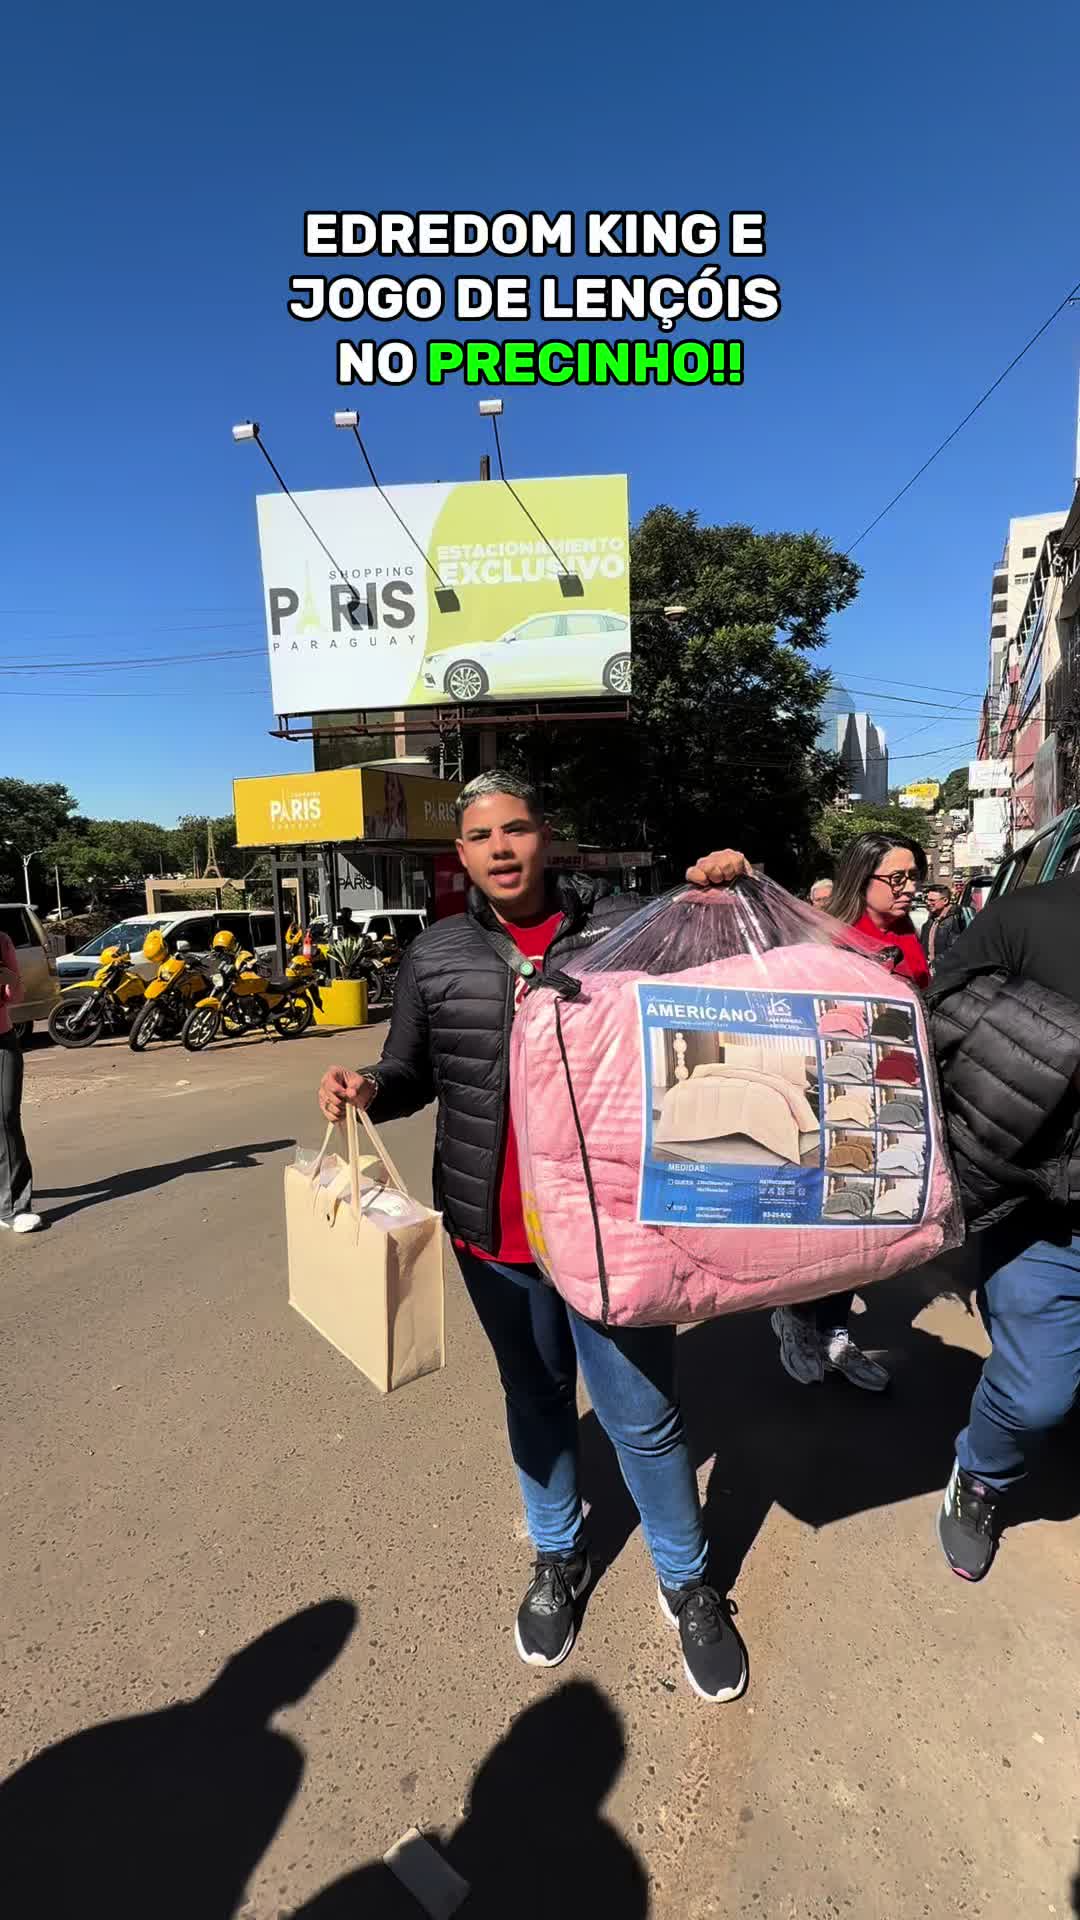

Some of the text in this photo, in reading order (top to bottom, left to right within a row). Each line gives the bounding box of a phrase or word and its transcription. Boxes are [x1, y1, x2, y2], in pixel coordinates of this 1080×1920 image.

[437, 537, 624, 561] ESTACIONAMIENTO
[329, 566, 415, 580] SHOPPING
[438, 553, 624, 586] EXCLUSIVO
[269, 579, 416, 636] PARIS
[273, 634, 416, 653] PARAGUAY
[271, 798, 321, 822] PARIS
[646, 1003, 758, 1022] AMERICANO
